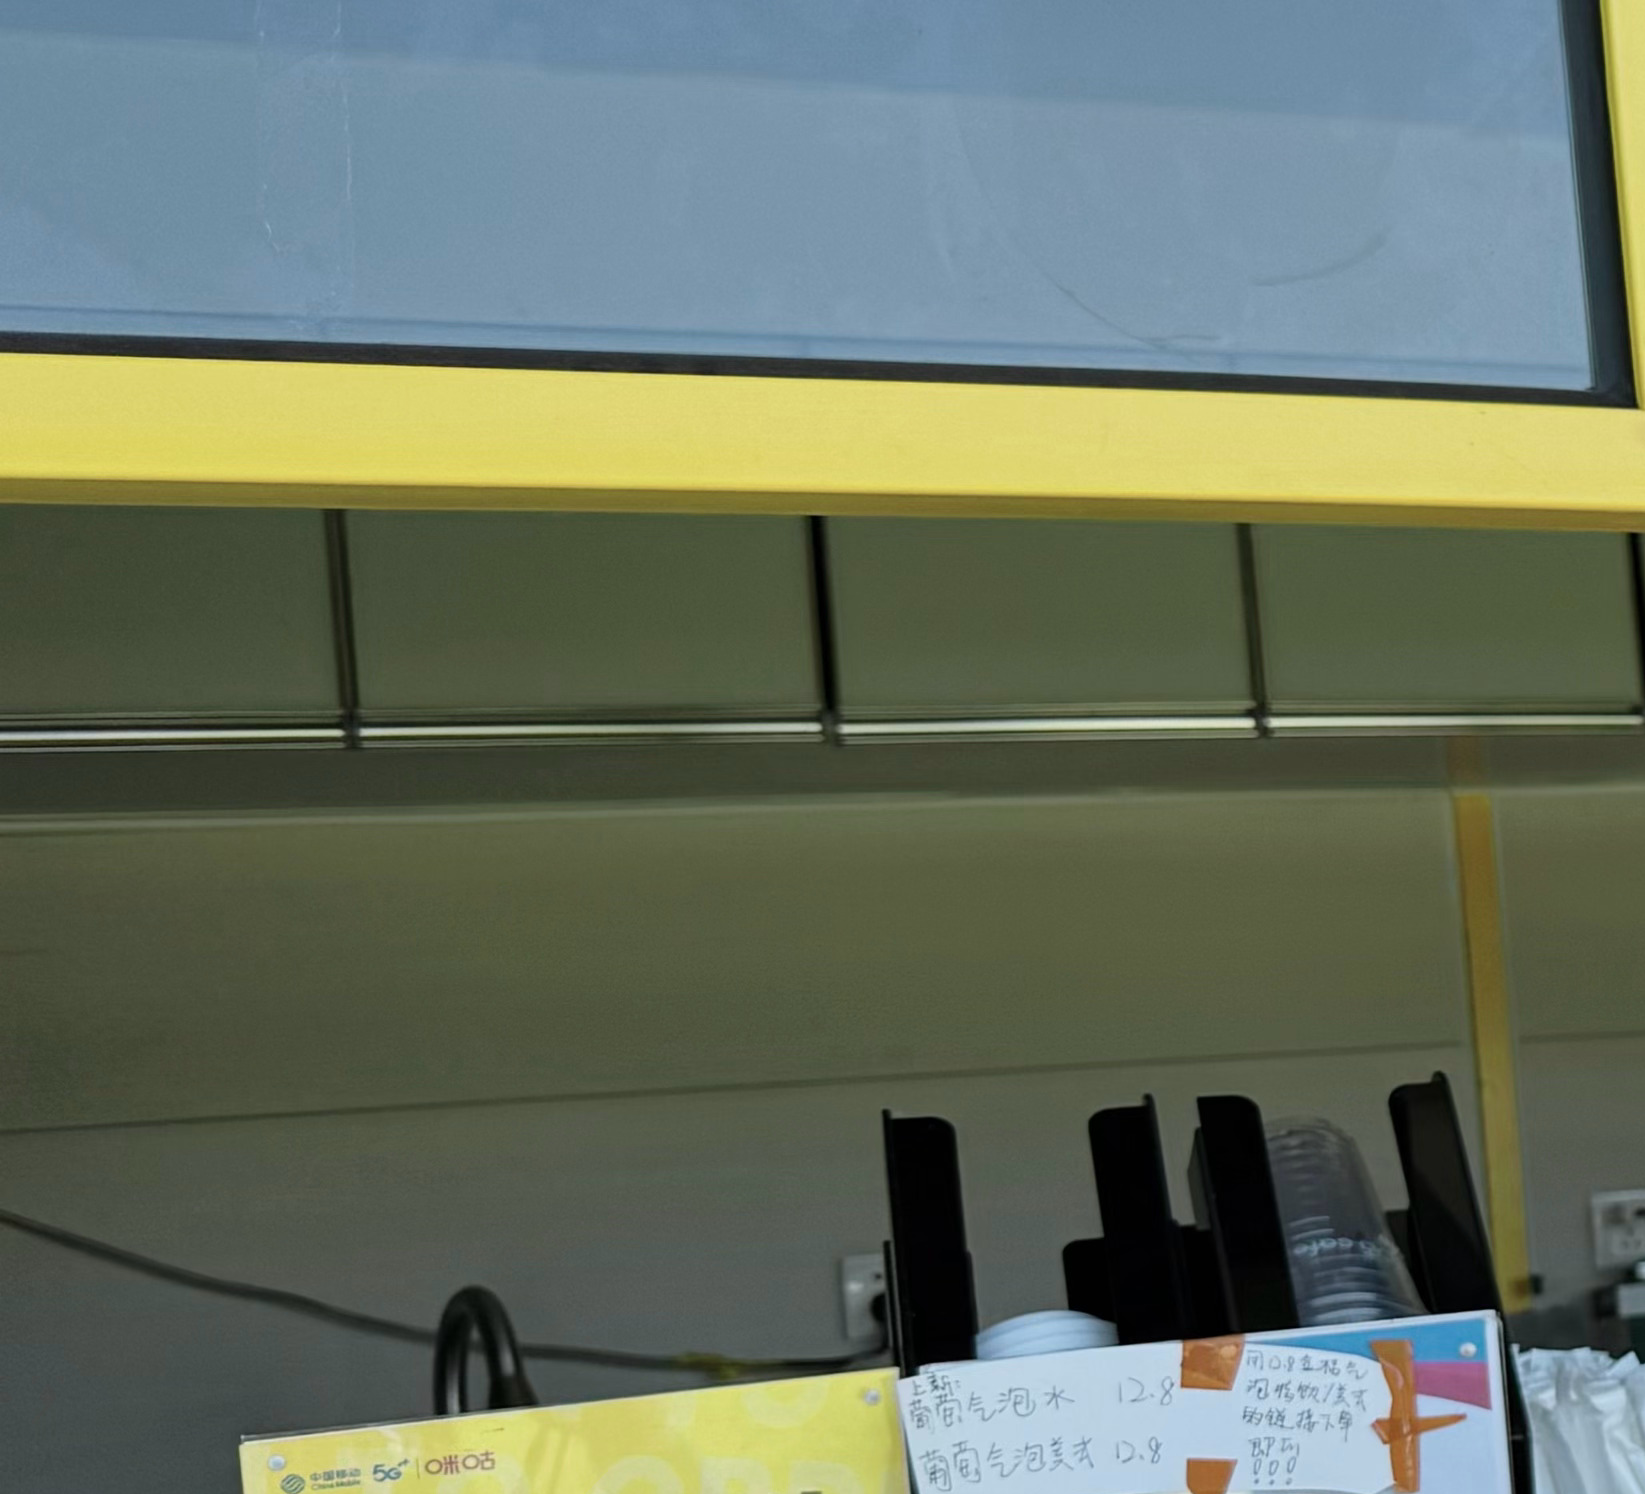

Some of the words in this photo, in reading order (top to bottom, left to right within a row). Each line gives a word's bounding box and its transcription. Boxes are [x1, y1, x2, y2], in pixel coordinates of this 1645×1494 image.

[1118, 1376, 1176, 1406] 12.8
[310, 1468, 361, 1482] 中国移动
[425, 1451, 495, 1475] 咪咕
